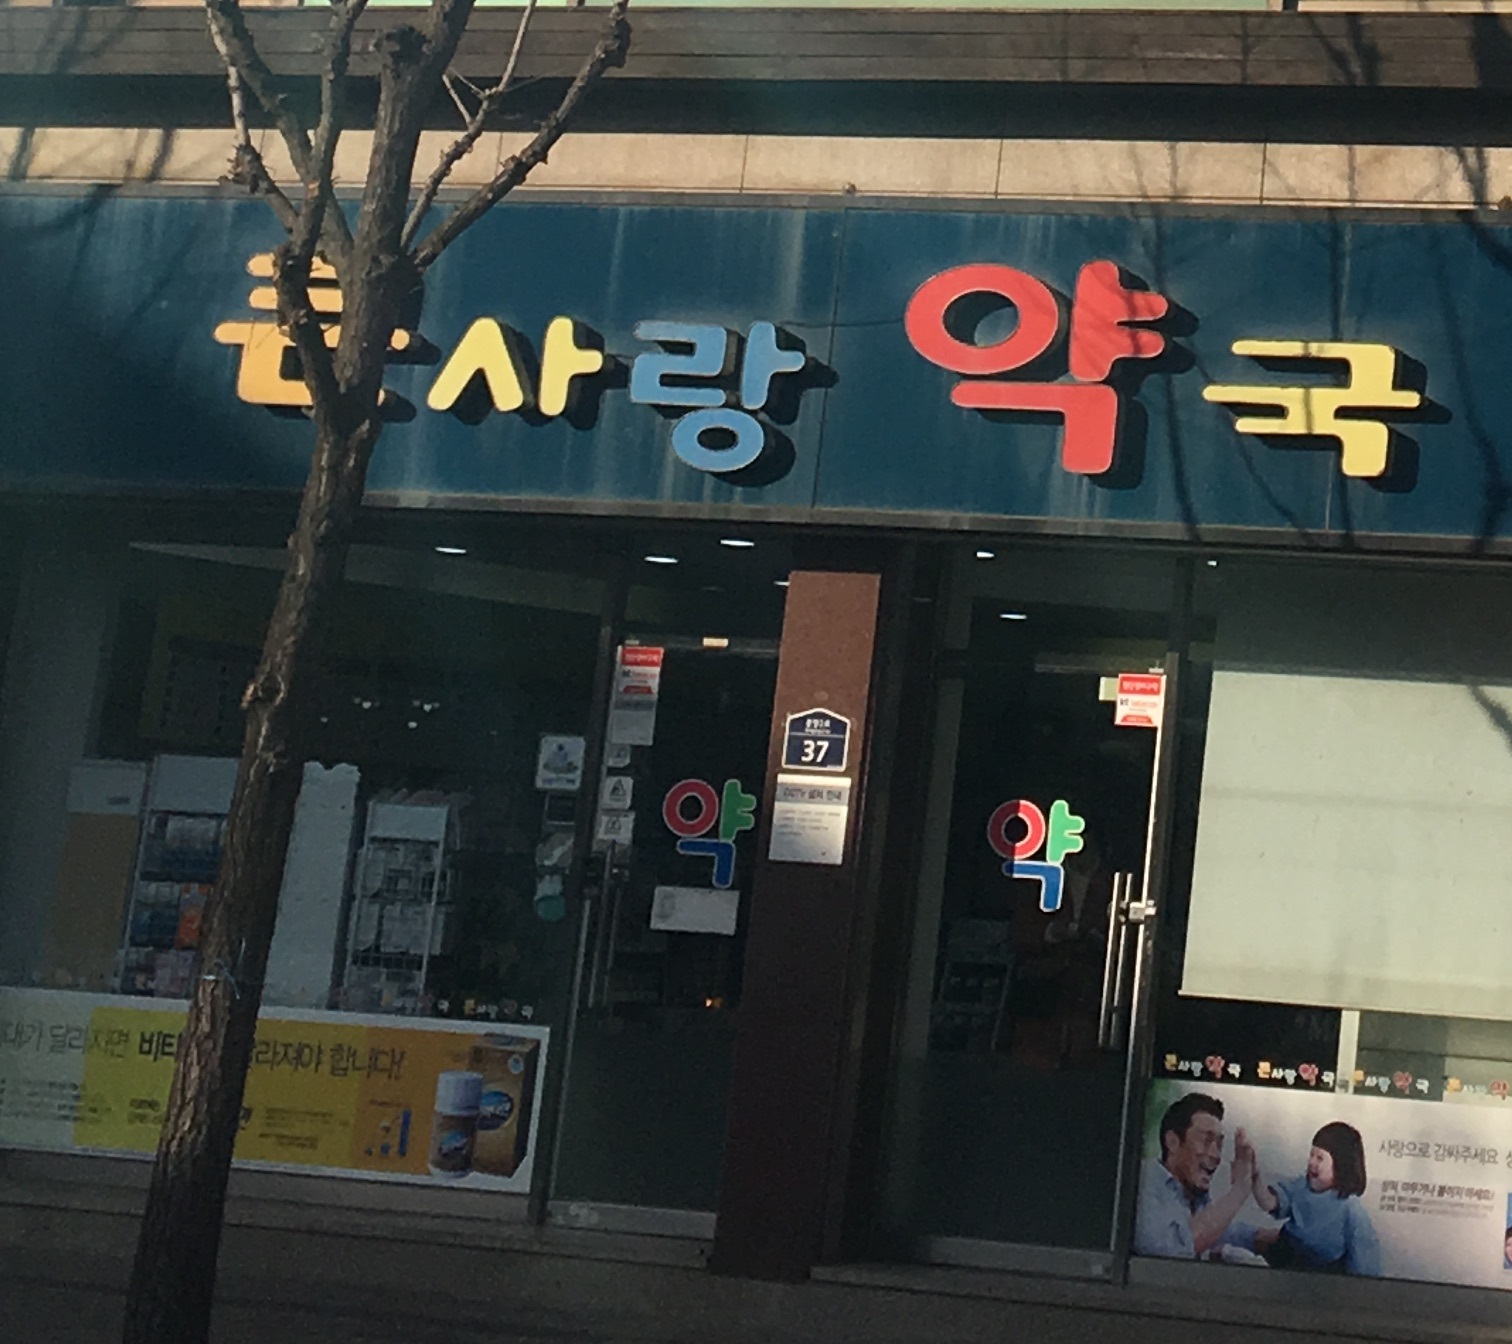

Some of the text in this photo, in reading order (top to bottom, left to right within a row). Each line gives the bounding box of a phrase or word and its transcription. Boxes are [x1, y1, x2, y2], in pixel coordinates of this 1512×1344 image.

[801, 739, 830, 763] 37
[662, 779, 757, 889] 약
[987, 799, 1086, 912] 약
